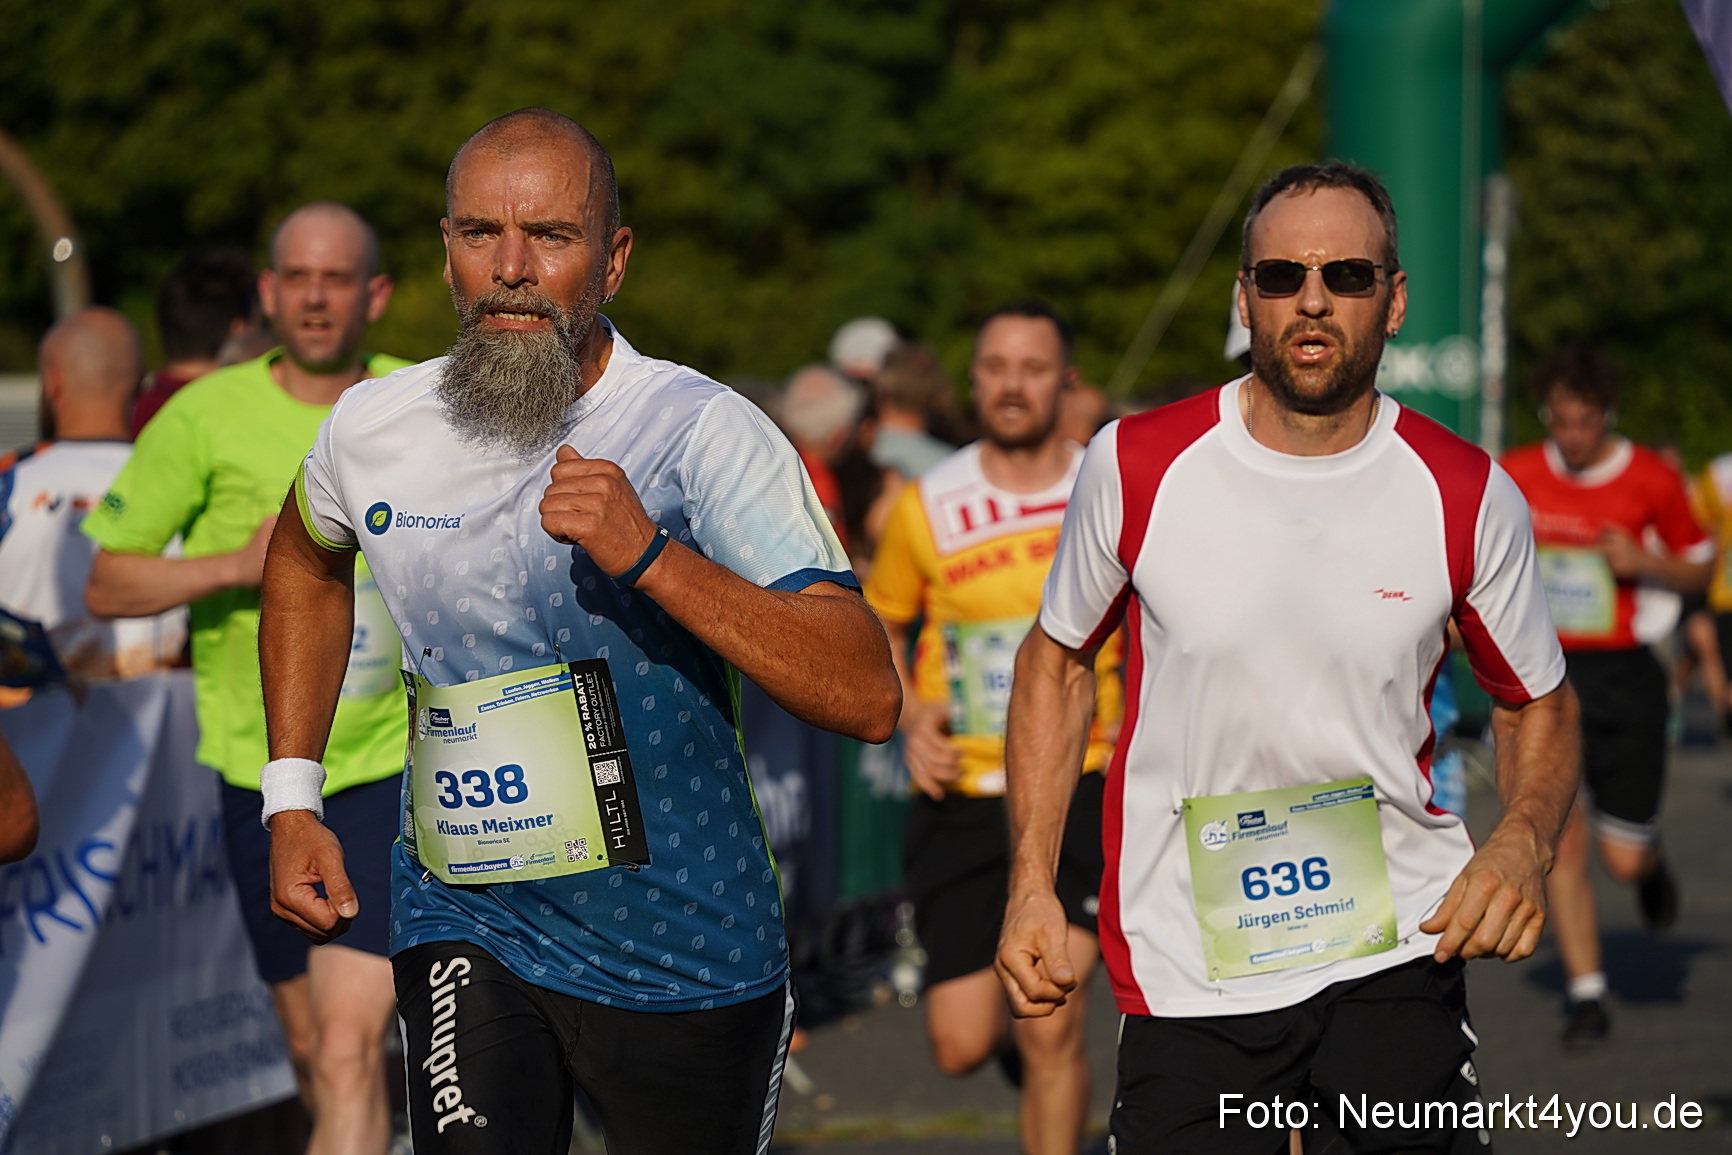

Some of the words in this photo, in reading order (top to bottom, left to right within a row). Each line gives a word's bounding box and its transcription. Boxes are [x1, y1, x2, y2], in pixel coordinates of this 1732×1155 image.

[395, 511, 463, 529] Bionorica
[574, 673, 591, 721] RABATT
[585, 672, 598, 707] OUTLET
[427, 722, 476, 737] Firmenlauf
[443, 733, 478, 744] neumarkt
[585, 722, 593, 732] %
[593, 708, 607, 748] FACTORY
[586, 733, 597, 750] 20
[435, 764, 529, 809] 338
[436, 819, 479, 836] Klaus
[481, 813, 554, 835] Meixner
[605, 790, 626, 849] HILTL
[1232, 820, 1288, 841] Firmenlauf
[450, 862, 508, 874] firmenlauf.bayern
[1241, 856, 1331, 901] 636
[1236, 909, 1290, 930] Jürgen
[1294, 897, 1355, 921] Schmid
